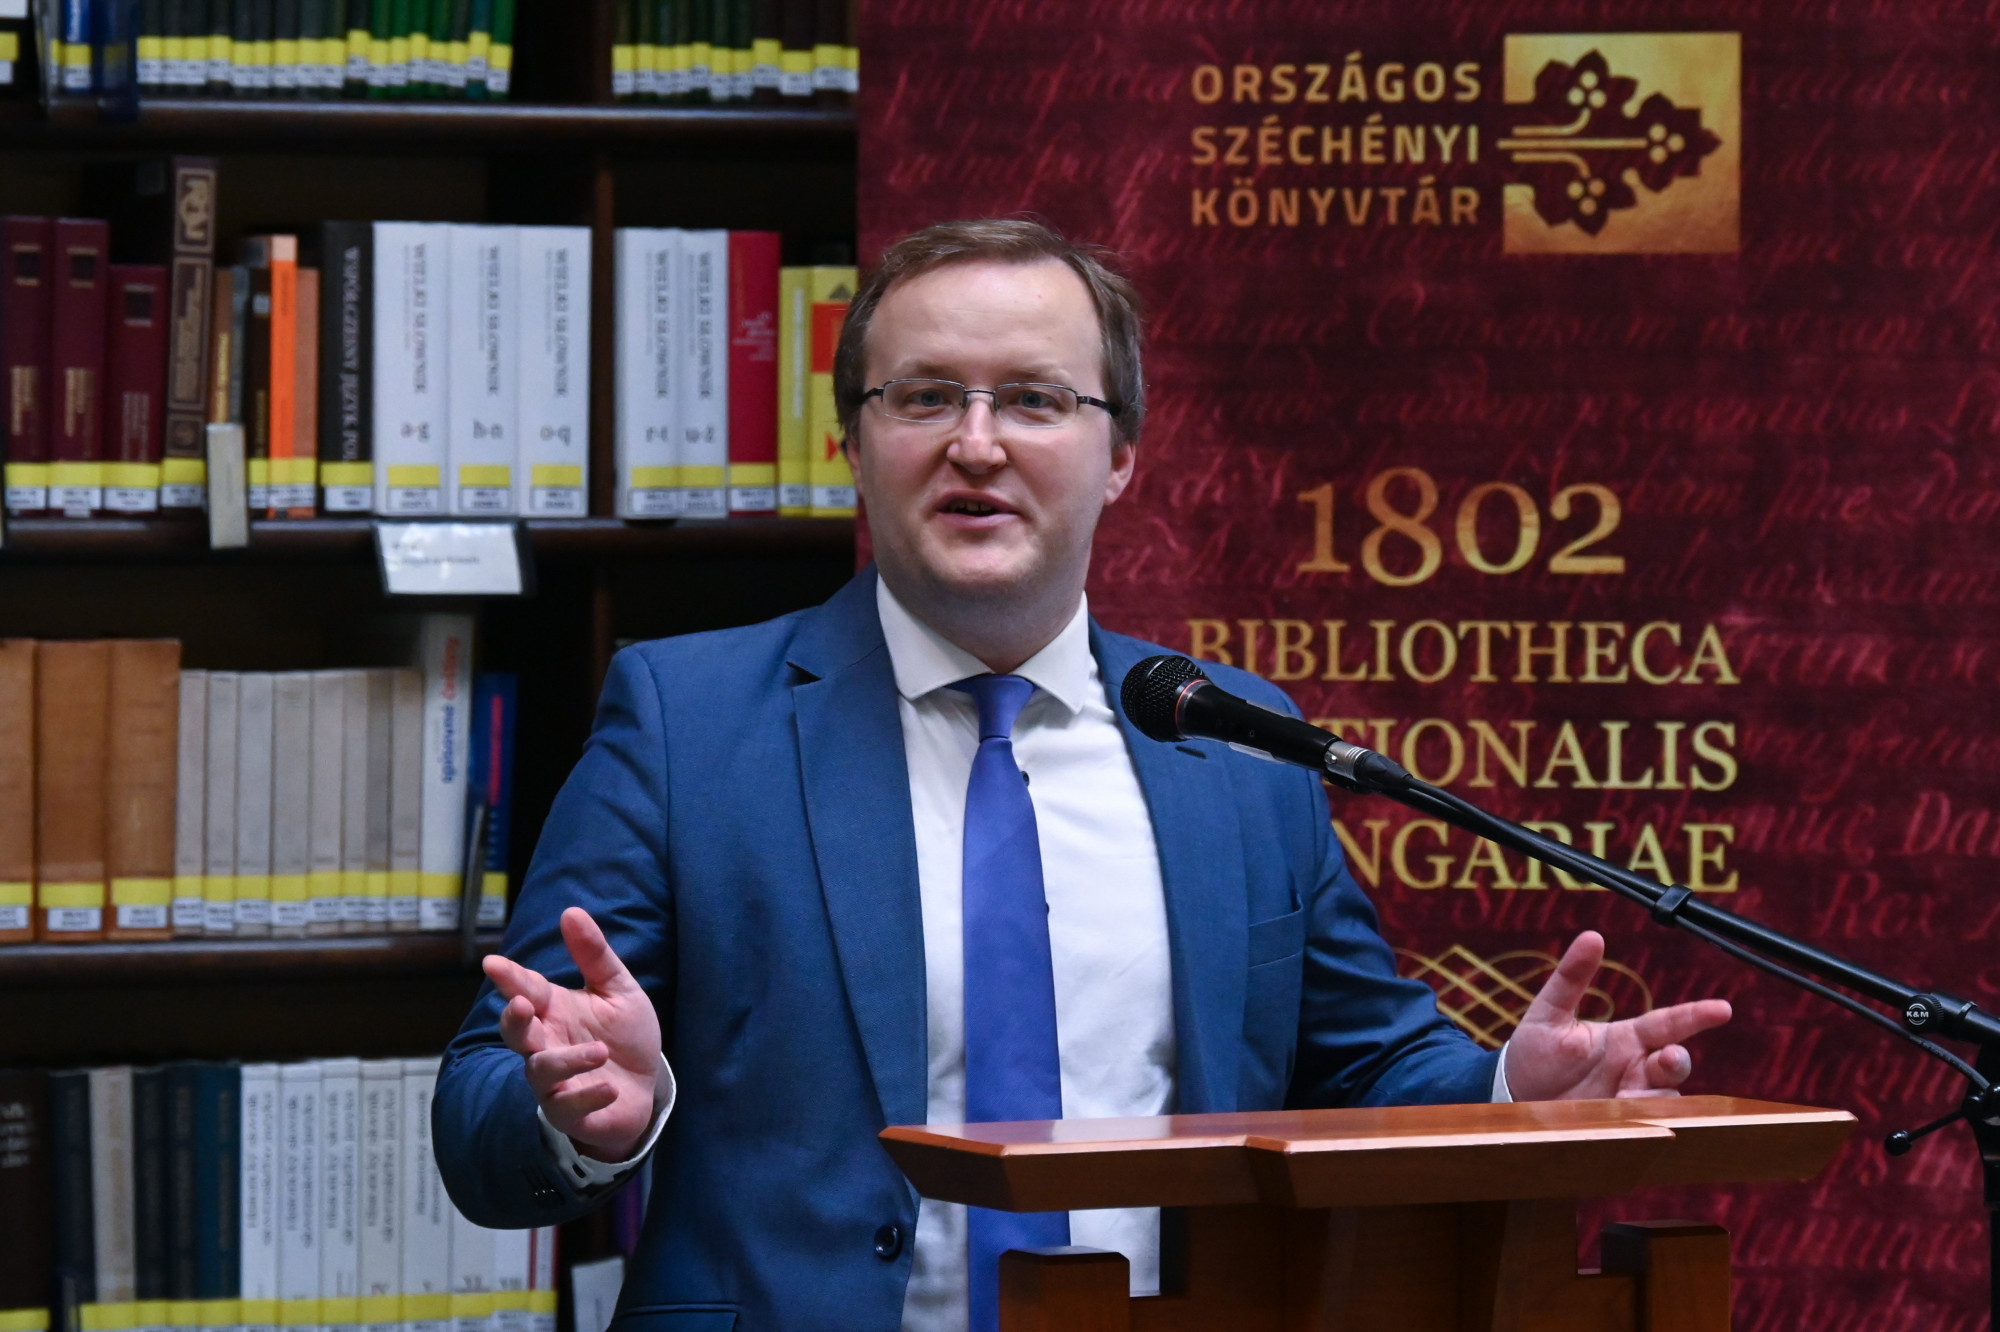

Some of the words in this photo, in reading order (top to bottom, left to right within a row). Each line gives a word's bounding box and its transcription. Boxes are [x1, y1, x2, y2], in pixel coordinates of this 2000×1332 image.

[1191, 51, 1481, 103] ORSZÁGOS
[1191, 113, 1479, 164] SZÉCHÉNYI
[1191, 175, 1480, 226] KÖNYVTÁR
[1297, 466, 1625, 587] 1802
[1186, 619, 1741, 685] BIBLIOTHECA
[1309, 718, 1738, 791] TIONALIS
[1331, 818, 1739, 893] NGARIAE
[1906, 1010, 1929, 1018] K&M
